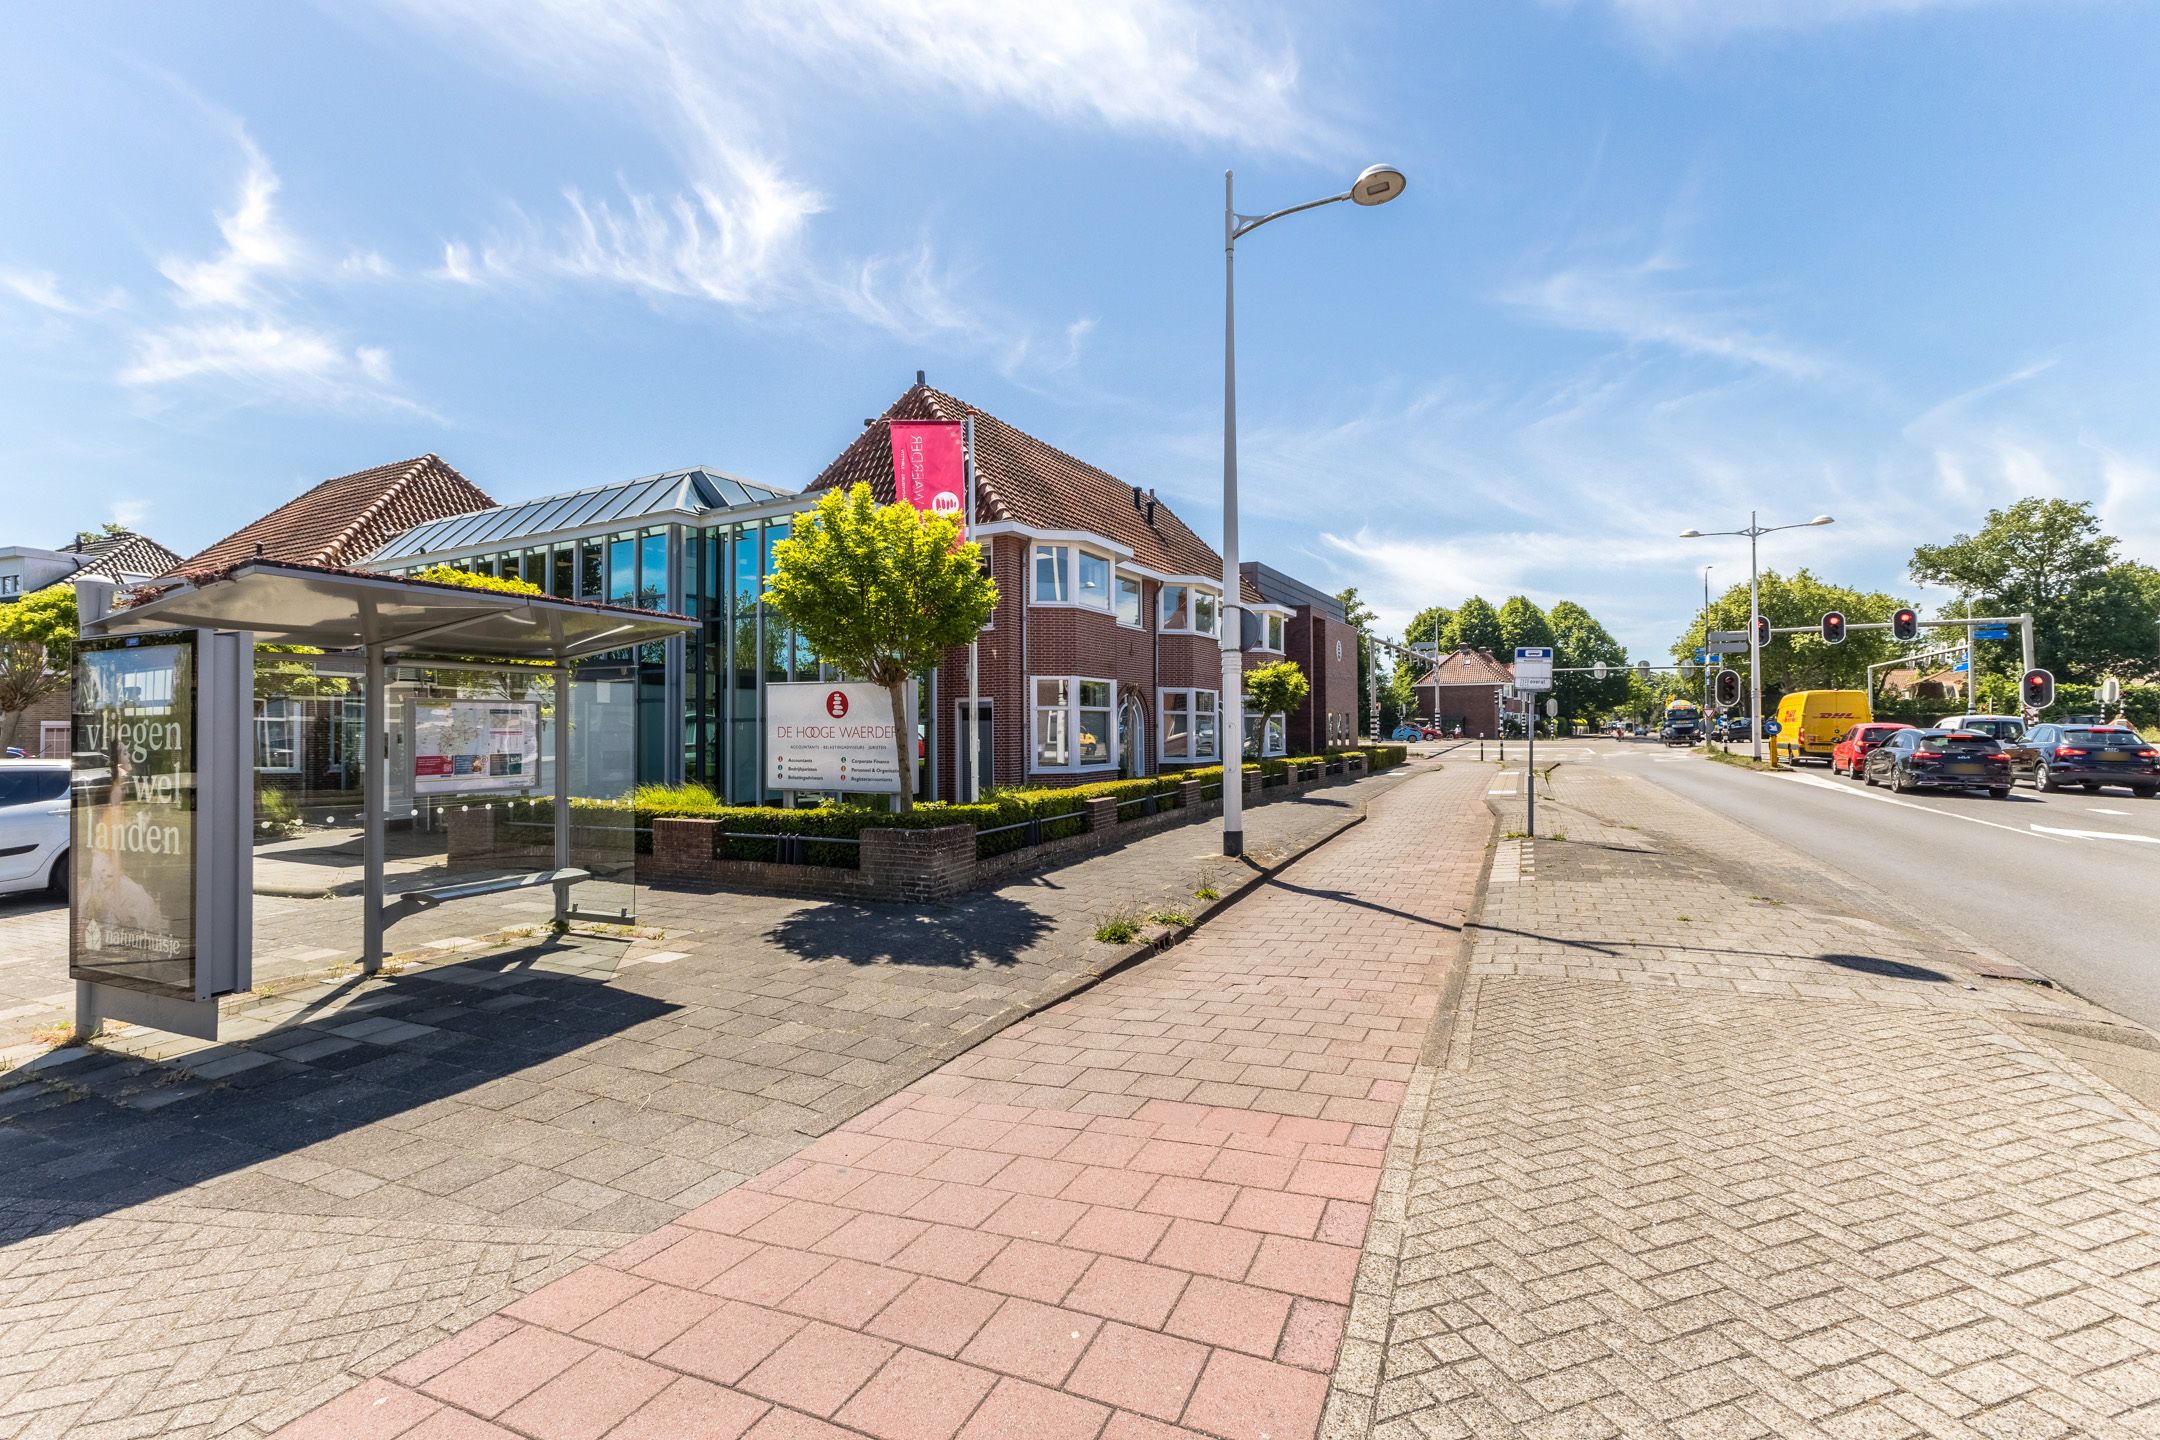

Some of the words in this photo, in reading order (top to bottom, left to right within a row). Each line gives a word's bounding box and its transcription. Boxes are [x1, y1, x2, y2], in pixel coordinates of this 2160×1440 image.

[86, 709, 182, 763] vliegen
[777, 726, 793, 739] DE
[796, 726, 836, 739] HOOGE
[132, 762, 182, 808] wel
[86, 811, 181, 855] landen
[104, 928, 181, 958] natuurhuisje
